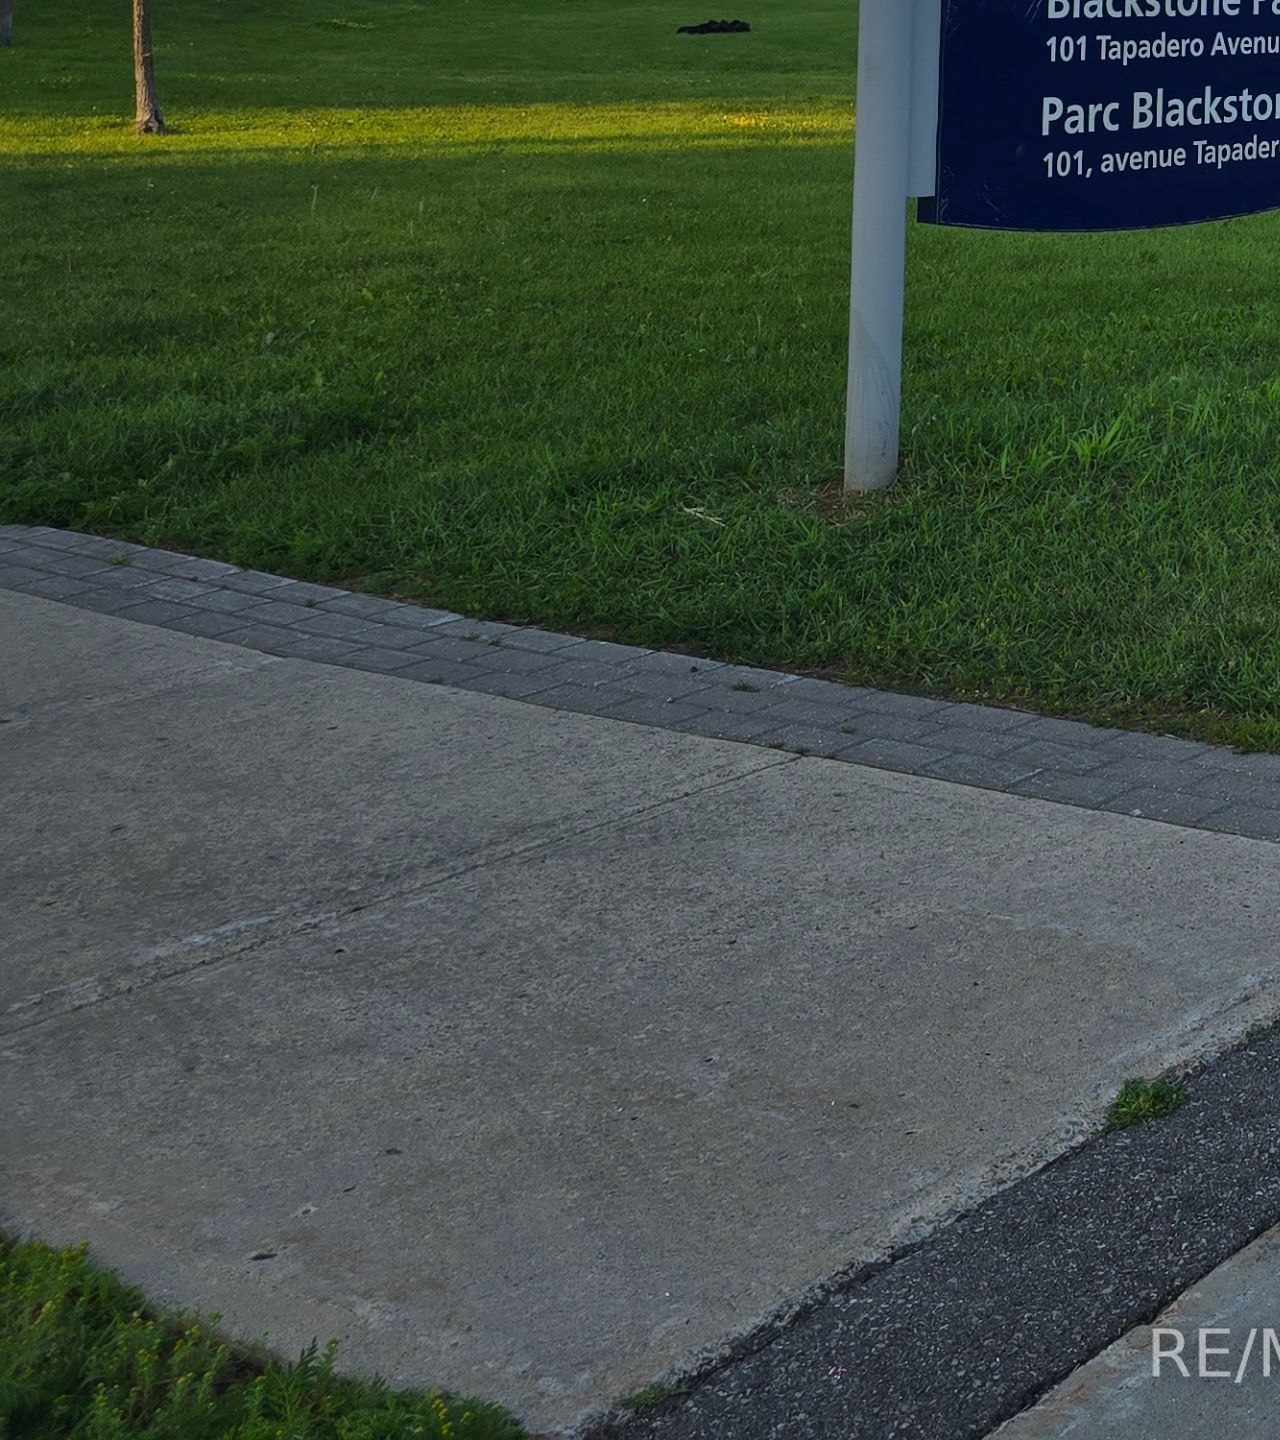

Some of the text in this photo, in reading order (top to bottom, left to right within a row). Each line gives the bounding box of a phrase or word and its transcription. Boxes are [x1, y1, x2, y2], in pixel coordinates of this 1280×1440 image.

[1046, 35, 1087, 62] 101
[1096, 31, 1204, 66] Tapadero
[1042, 96, 1120, 136] Parc
[1043, 151, 1093, 179] 101,
[1100, 147, 1187, 173] avenue
